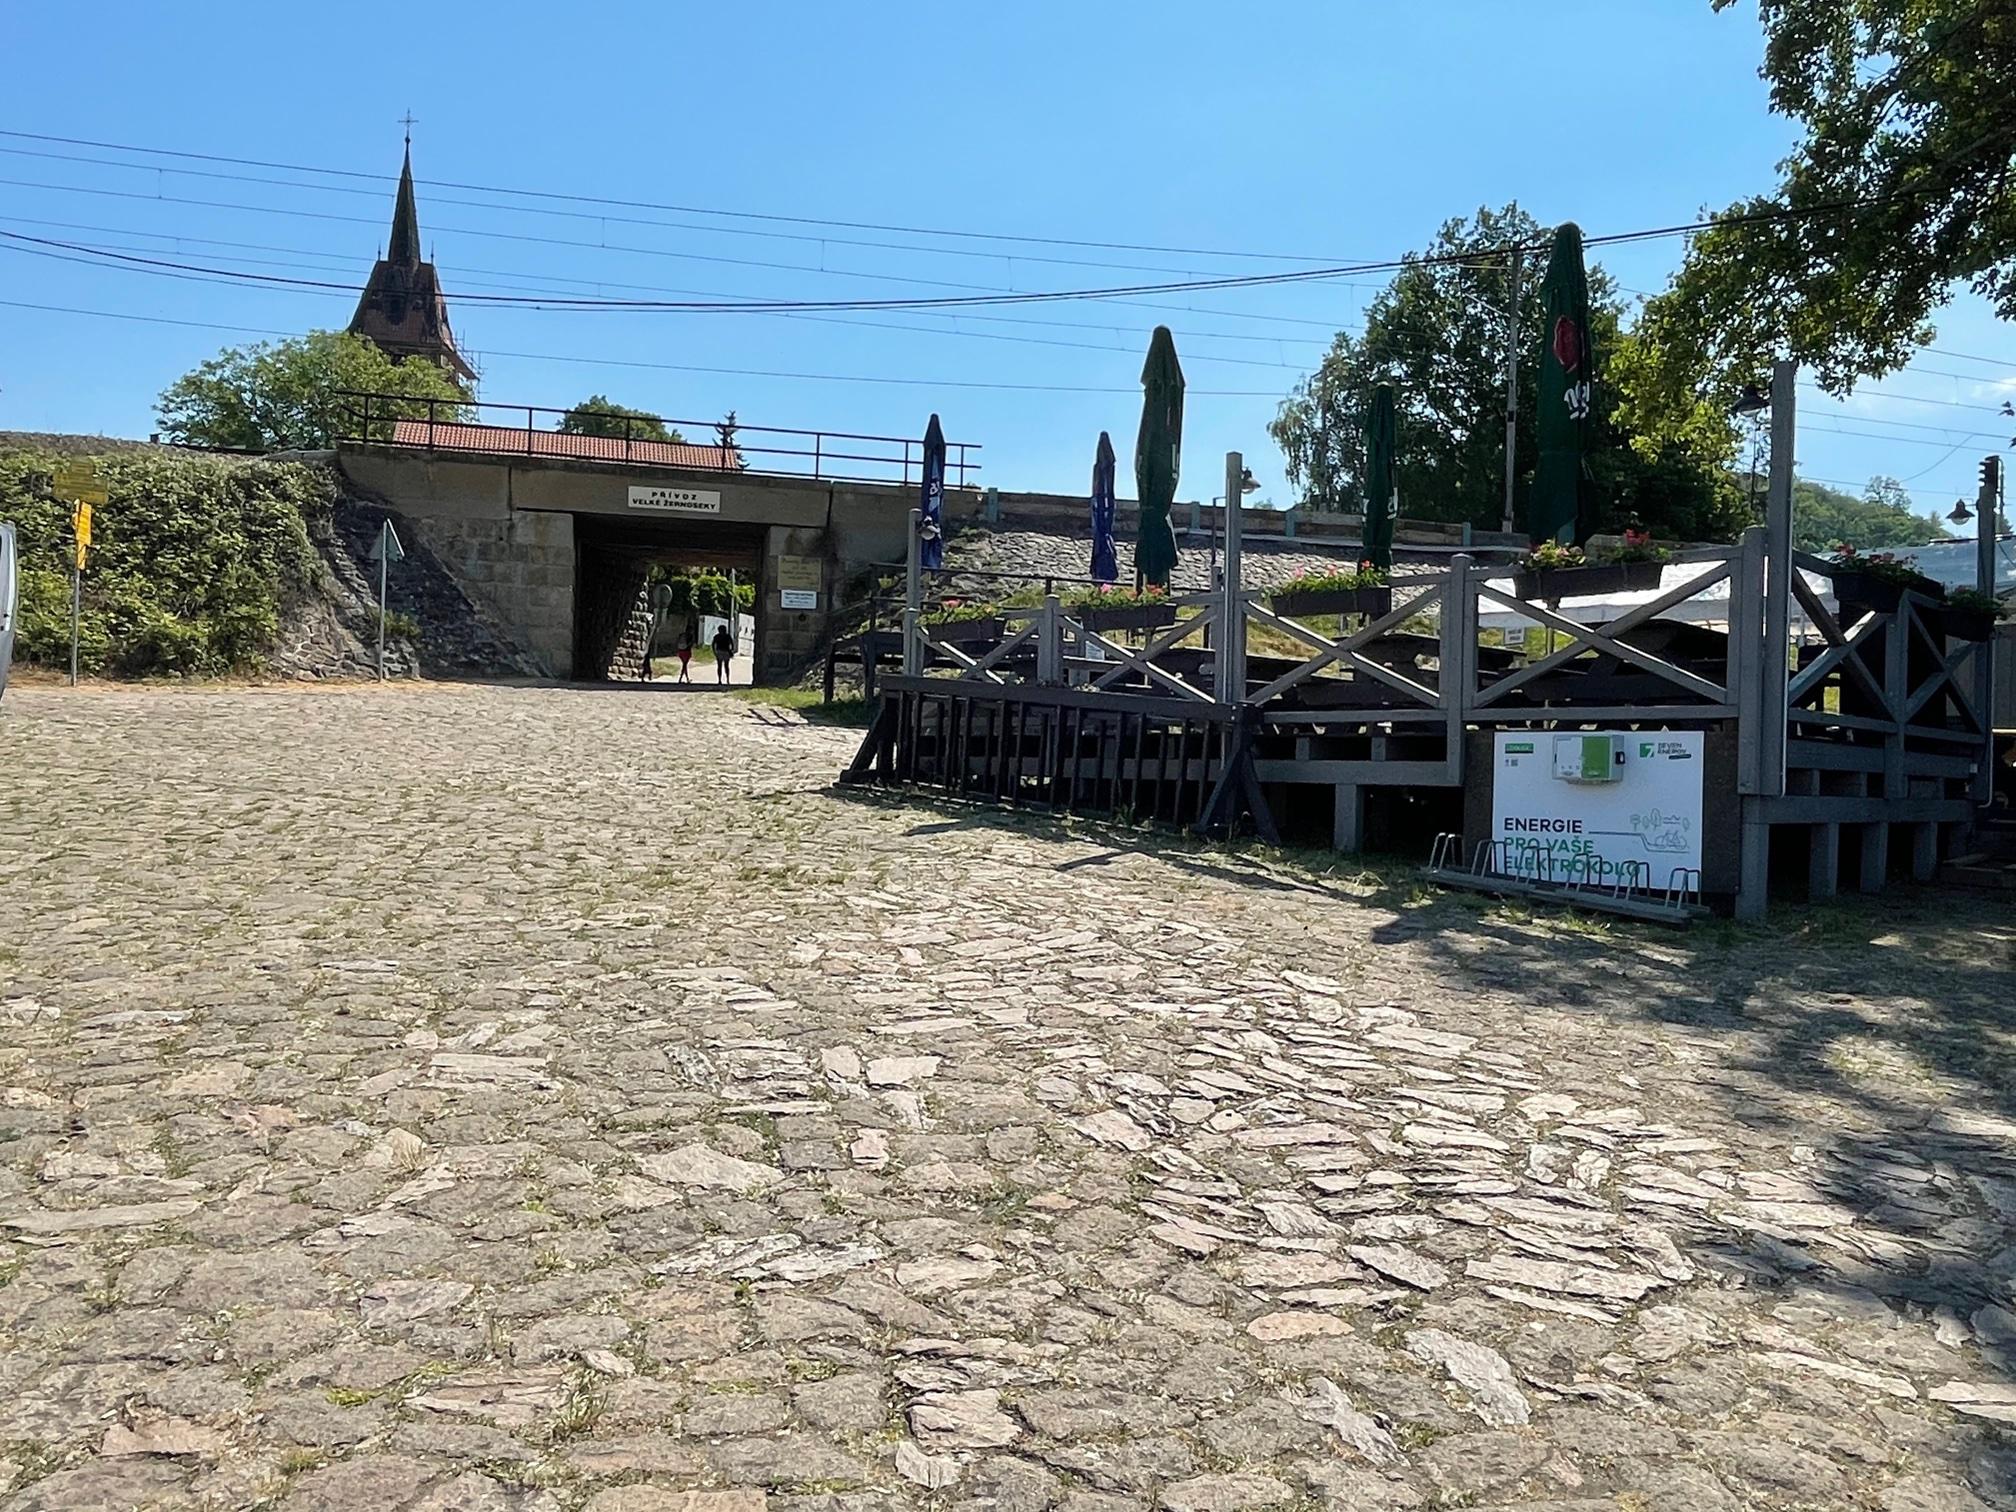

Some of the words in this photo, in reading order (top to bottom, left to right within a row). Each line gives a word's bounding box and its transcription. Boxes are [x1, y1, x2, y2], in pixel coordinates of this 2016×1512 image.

[632, 498, 660, 506] VELKÉ
[663, 499, 716, 510] ŽERNOSEKY
[651, 491, 697, 500] PŘÍVOZ
[1504, 817, 1583, 834] ENERGIE
[1504, 836, 1540, 851] PRO
[1546, 835, 1595, 854] VAŠE
[1505, 855, 1641, 876] ELEKTROKOLO
